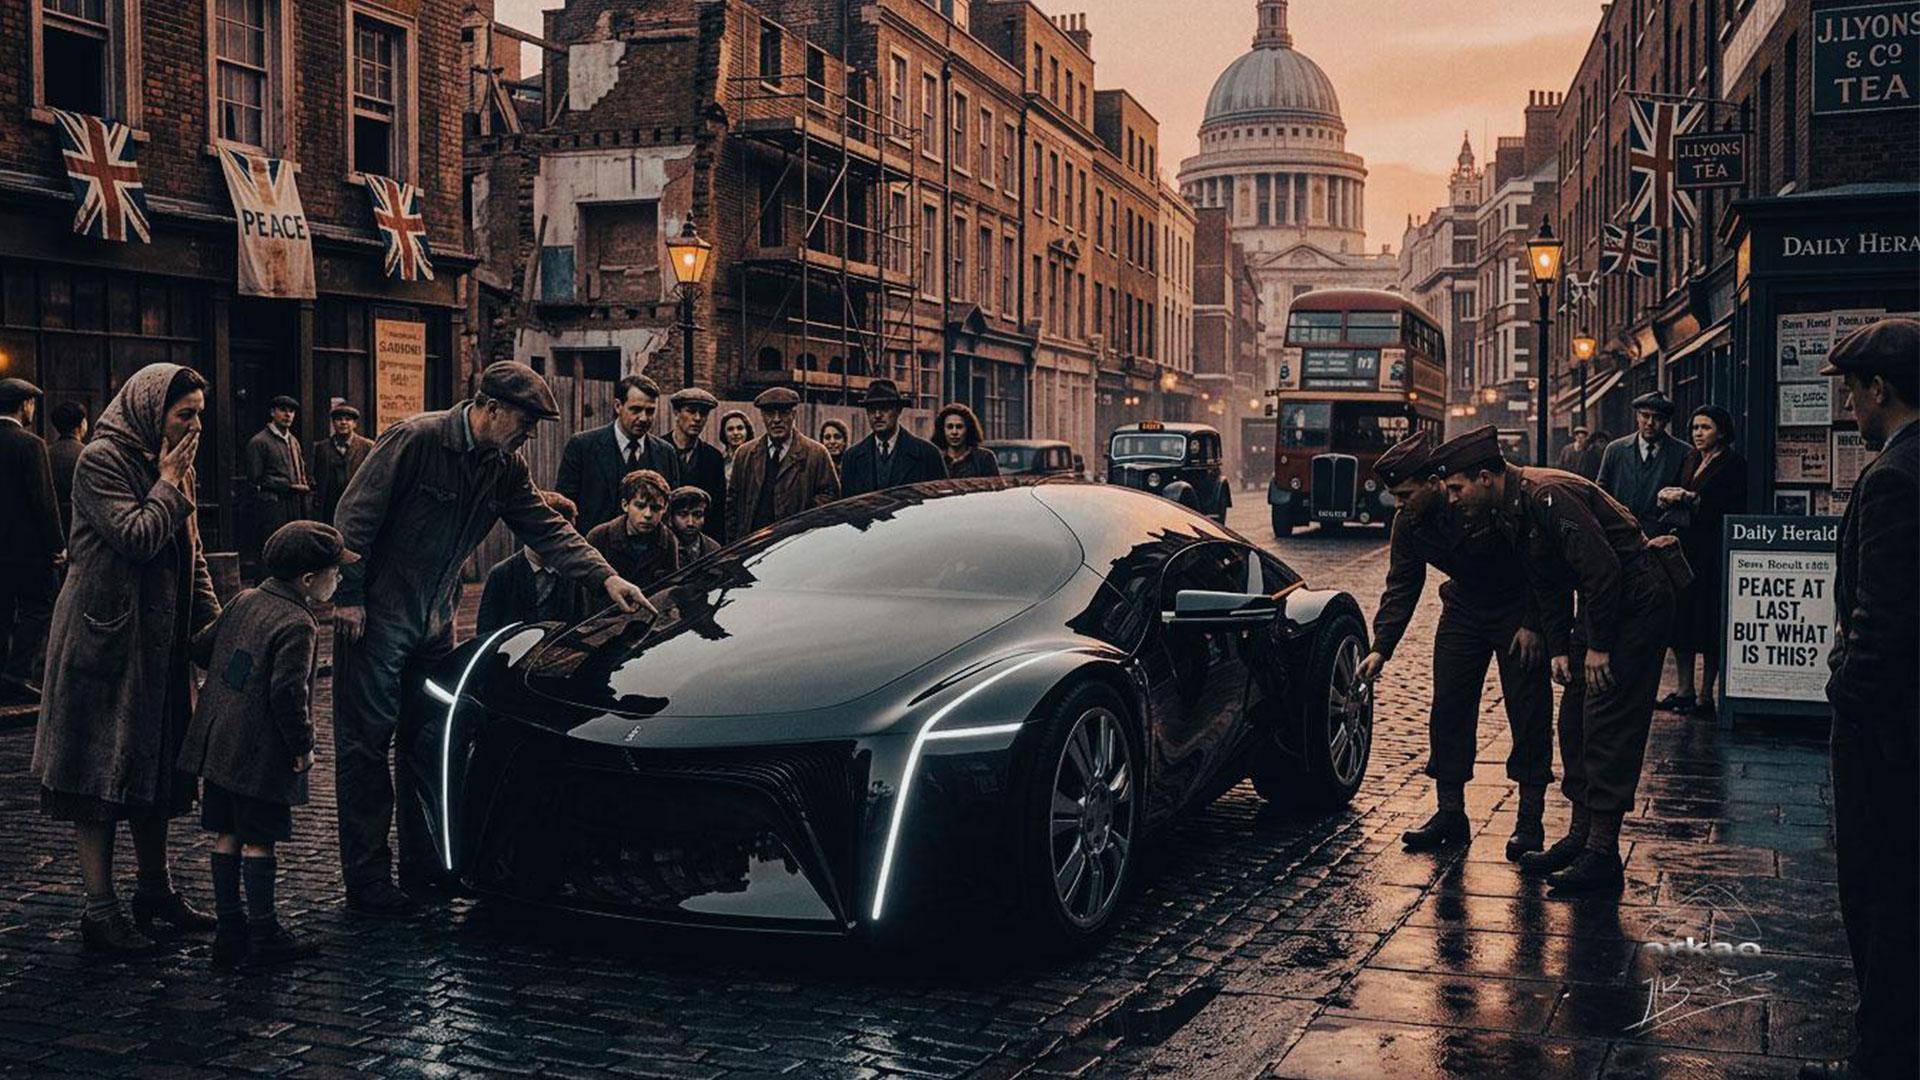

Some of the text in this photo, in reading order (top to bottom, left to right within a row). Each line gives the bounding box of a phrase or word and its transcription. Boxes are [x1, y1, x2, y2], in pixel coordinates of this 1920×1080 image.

[1846, 51, 1862, 68] &
[1834, 74, 1910, 104] TEA
[1692, 164, 1728, 178] TEA
[242, 208, 307, 240] PEACE
[1733, 523, 1838, 544] Daily Herald
[1738, 577, 1825, 599] PEACE AT
[1756, 600, 1805, 623] LAST,
[1734, 622, 1828, 643] BUT WHAT
[1742, 644, 1818, 667] IS THIS?
